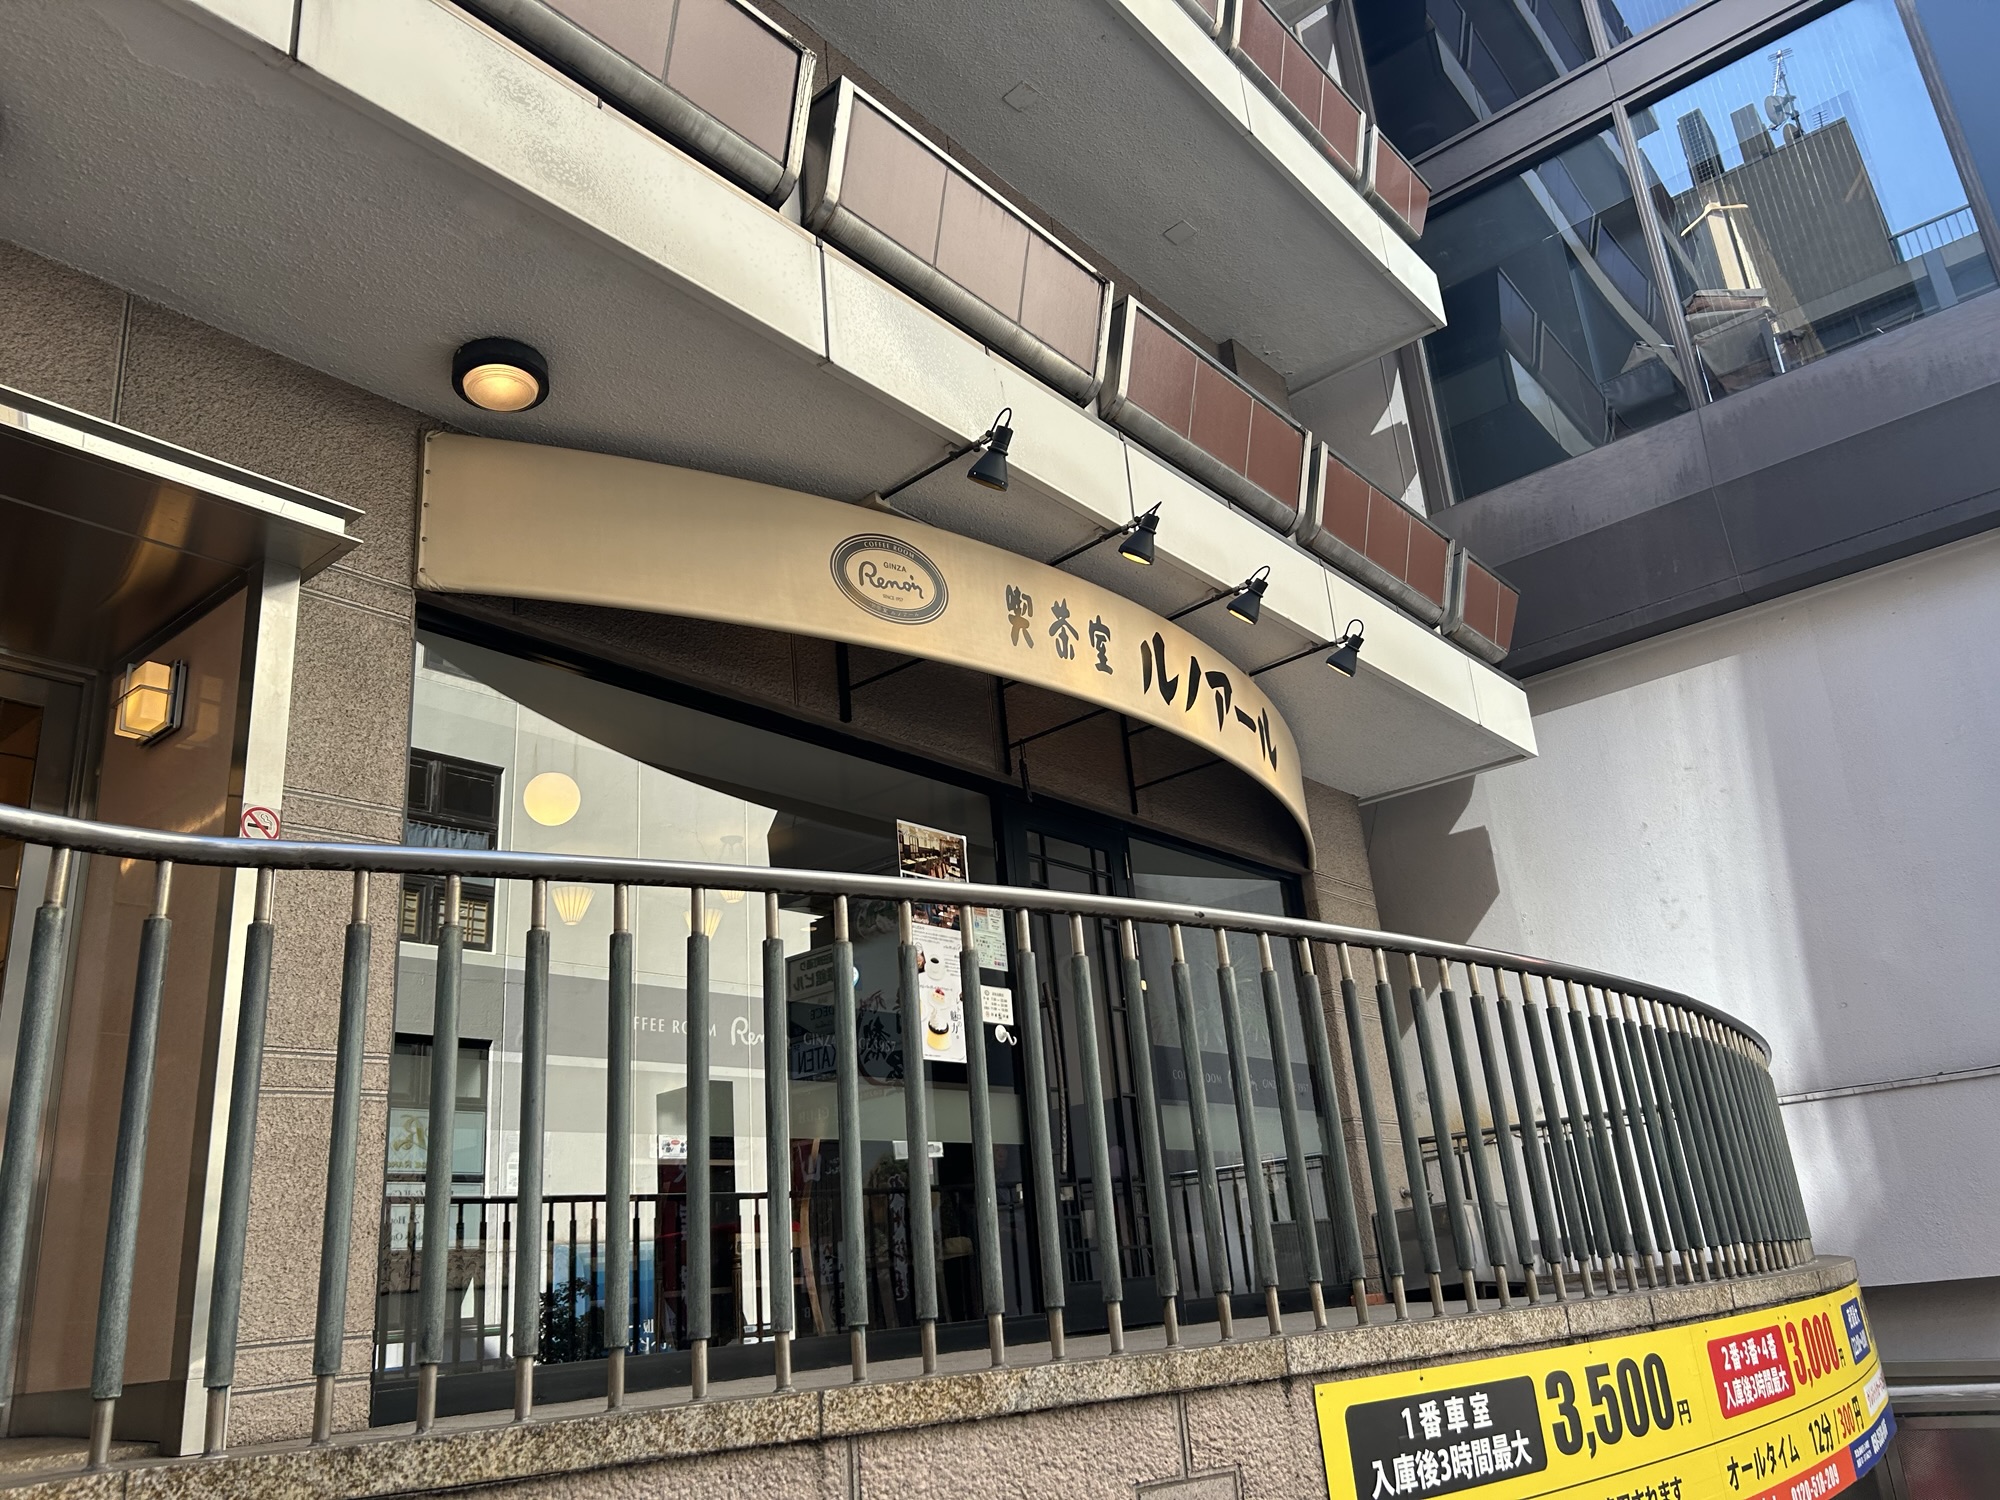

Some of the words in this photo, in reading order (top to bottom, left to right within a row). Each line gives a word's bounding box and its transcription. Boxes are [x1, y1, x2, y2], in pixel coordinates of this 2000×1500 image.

[863, 541, 890, 549] COFFEE
[893, 546, 915, 559] ROOM
[883, 561, 907, 573] GINZA
[1005, 584, 1113, 675] 喫茶室
[1140, 631, 1278, 772] ルノアール
[633, 1016, 665, 1033] FFEE
[672, 1019, 717, 1037] ROM
[730, 1016, 765, 1046] Ren
[1785, 1311, 1847, 1388] 3,000円
[1545, 1352, 1692, 1459] 3,500円
[1723, 1364, 1790, 1409] 入庫後3時間最大
[1401, 1391, 1493, 1440] 1番車室
[1371, 1429, 1533, 1500] 入庫後3時間最大
[1727, 1433, 1800, 1491] オールタイム
